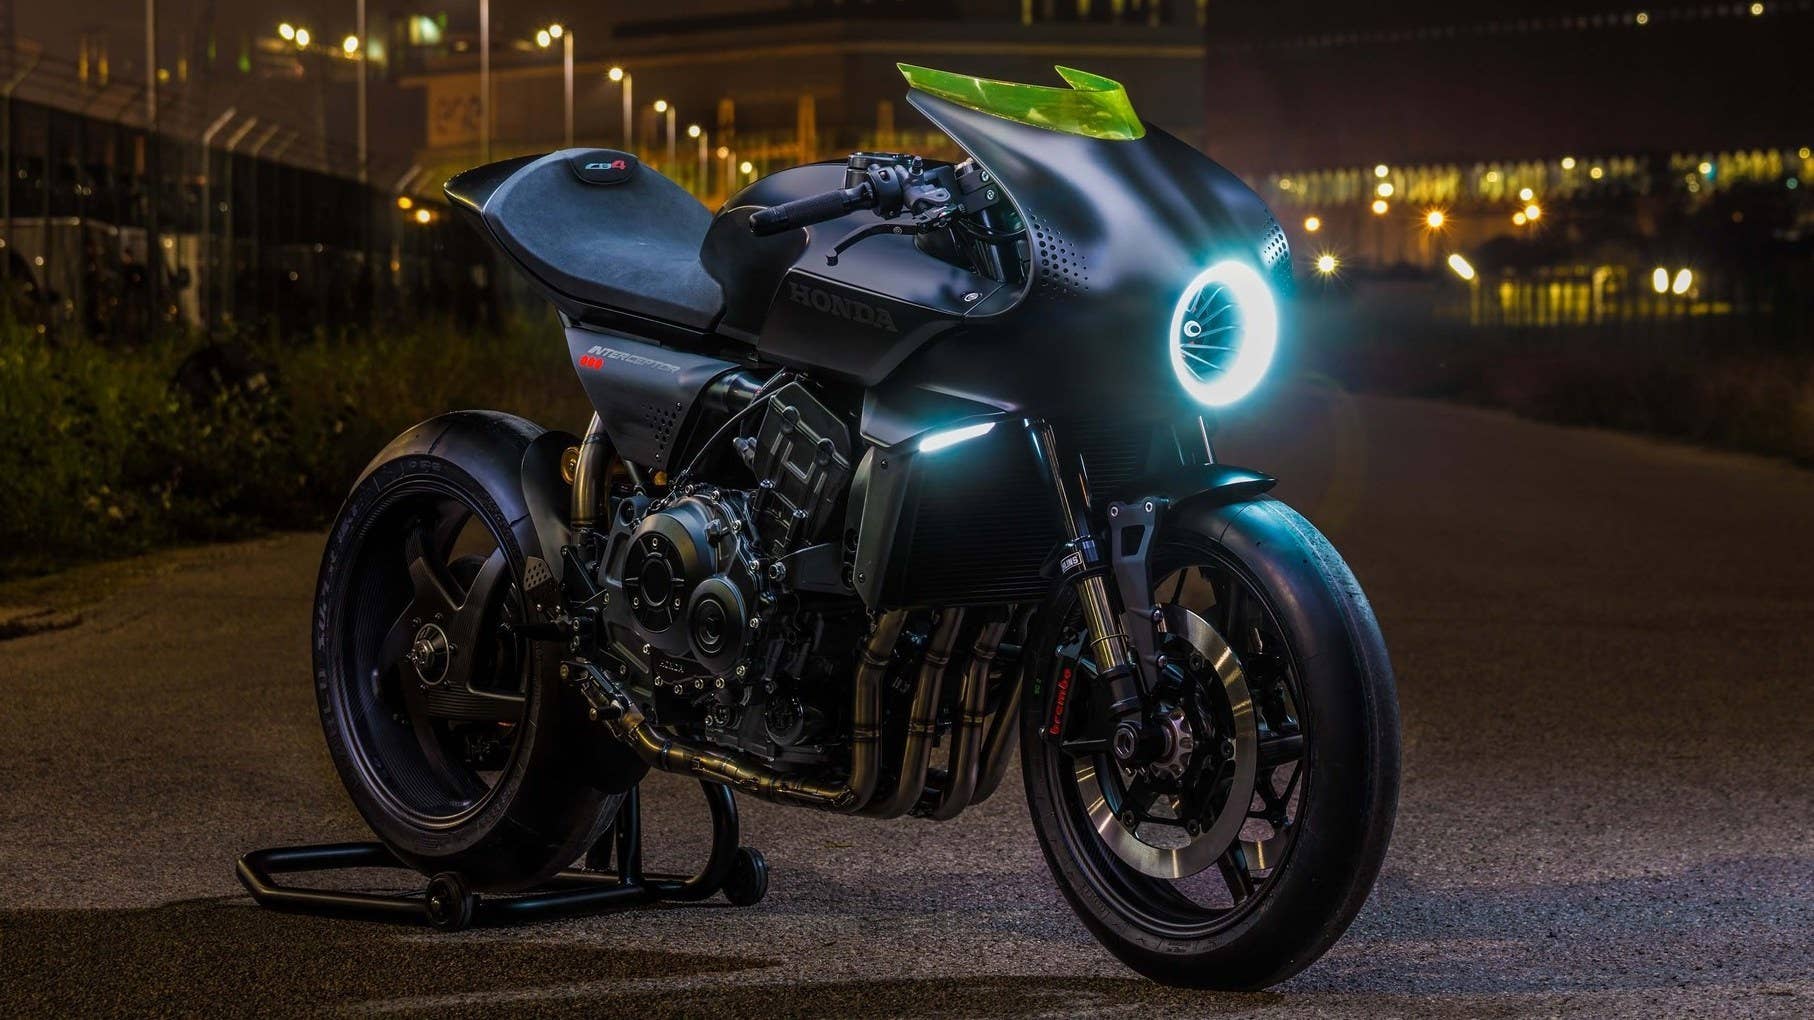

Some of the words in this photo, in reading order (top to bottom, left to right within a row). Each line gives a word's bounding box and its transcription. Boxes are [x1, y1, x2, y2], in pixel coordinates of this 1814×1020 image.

[788, 281, 902, 334] HONDA
[588, 345, 681, 374] INTERCEPTOR
[1049, 666, 1072, 735] brembo
